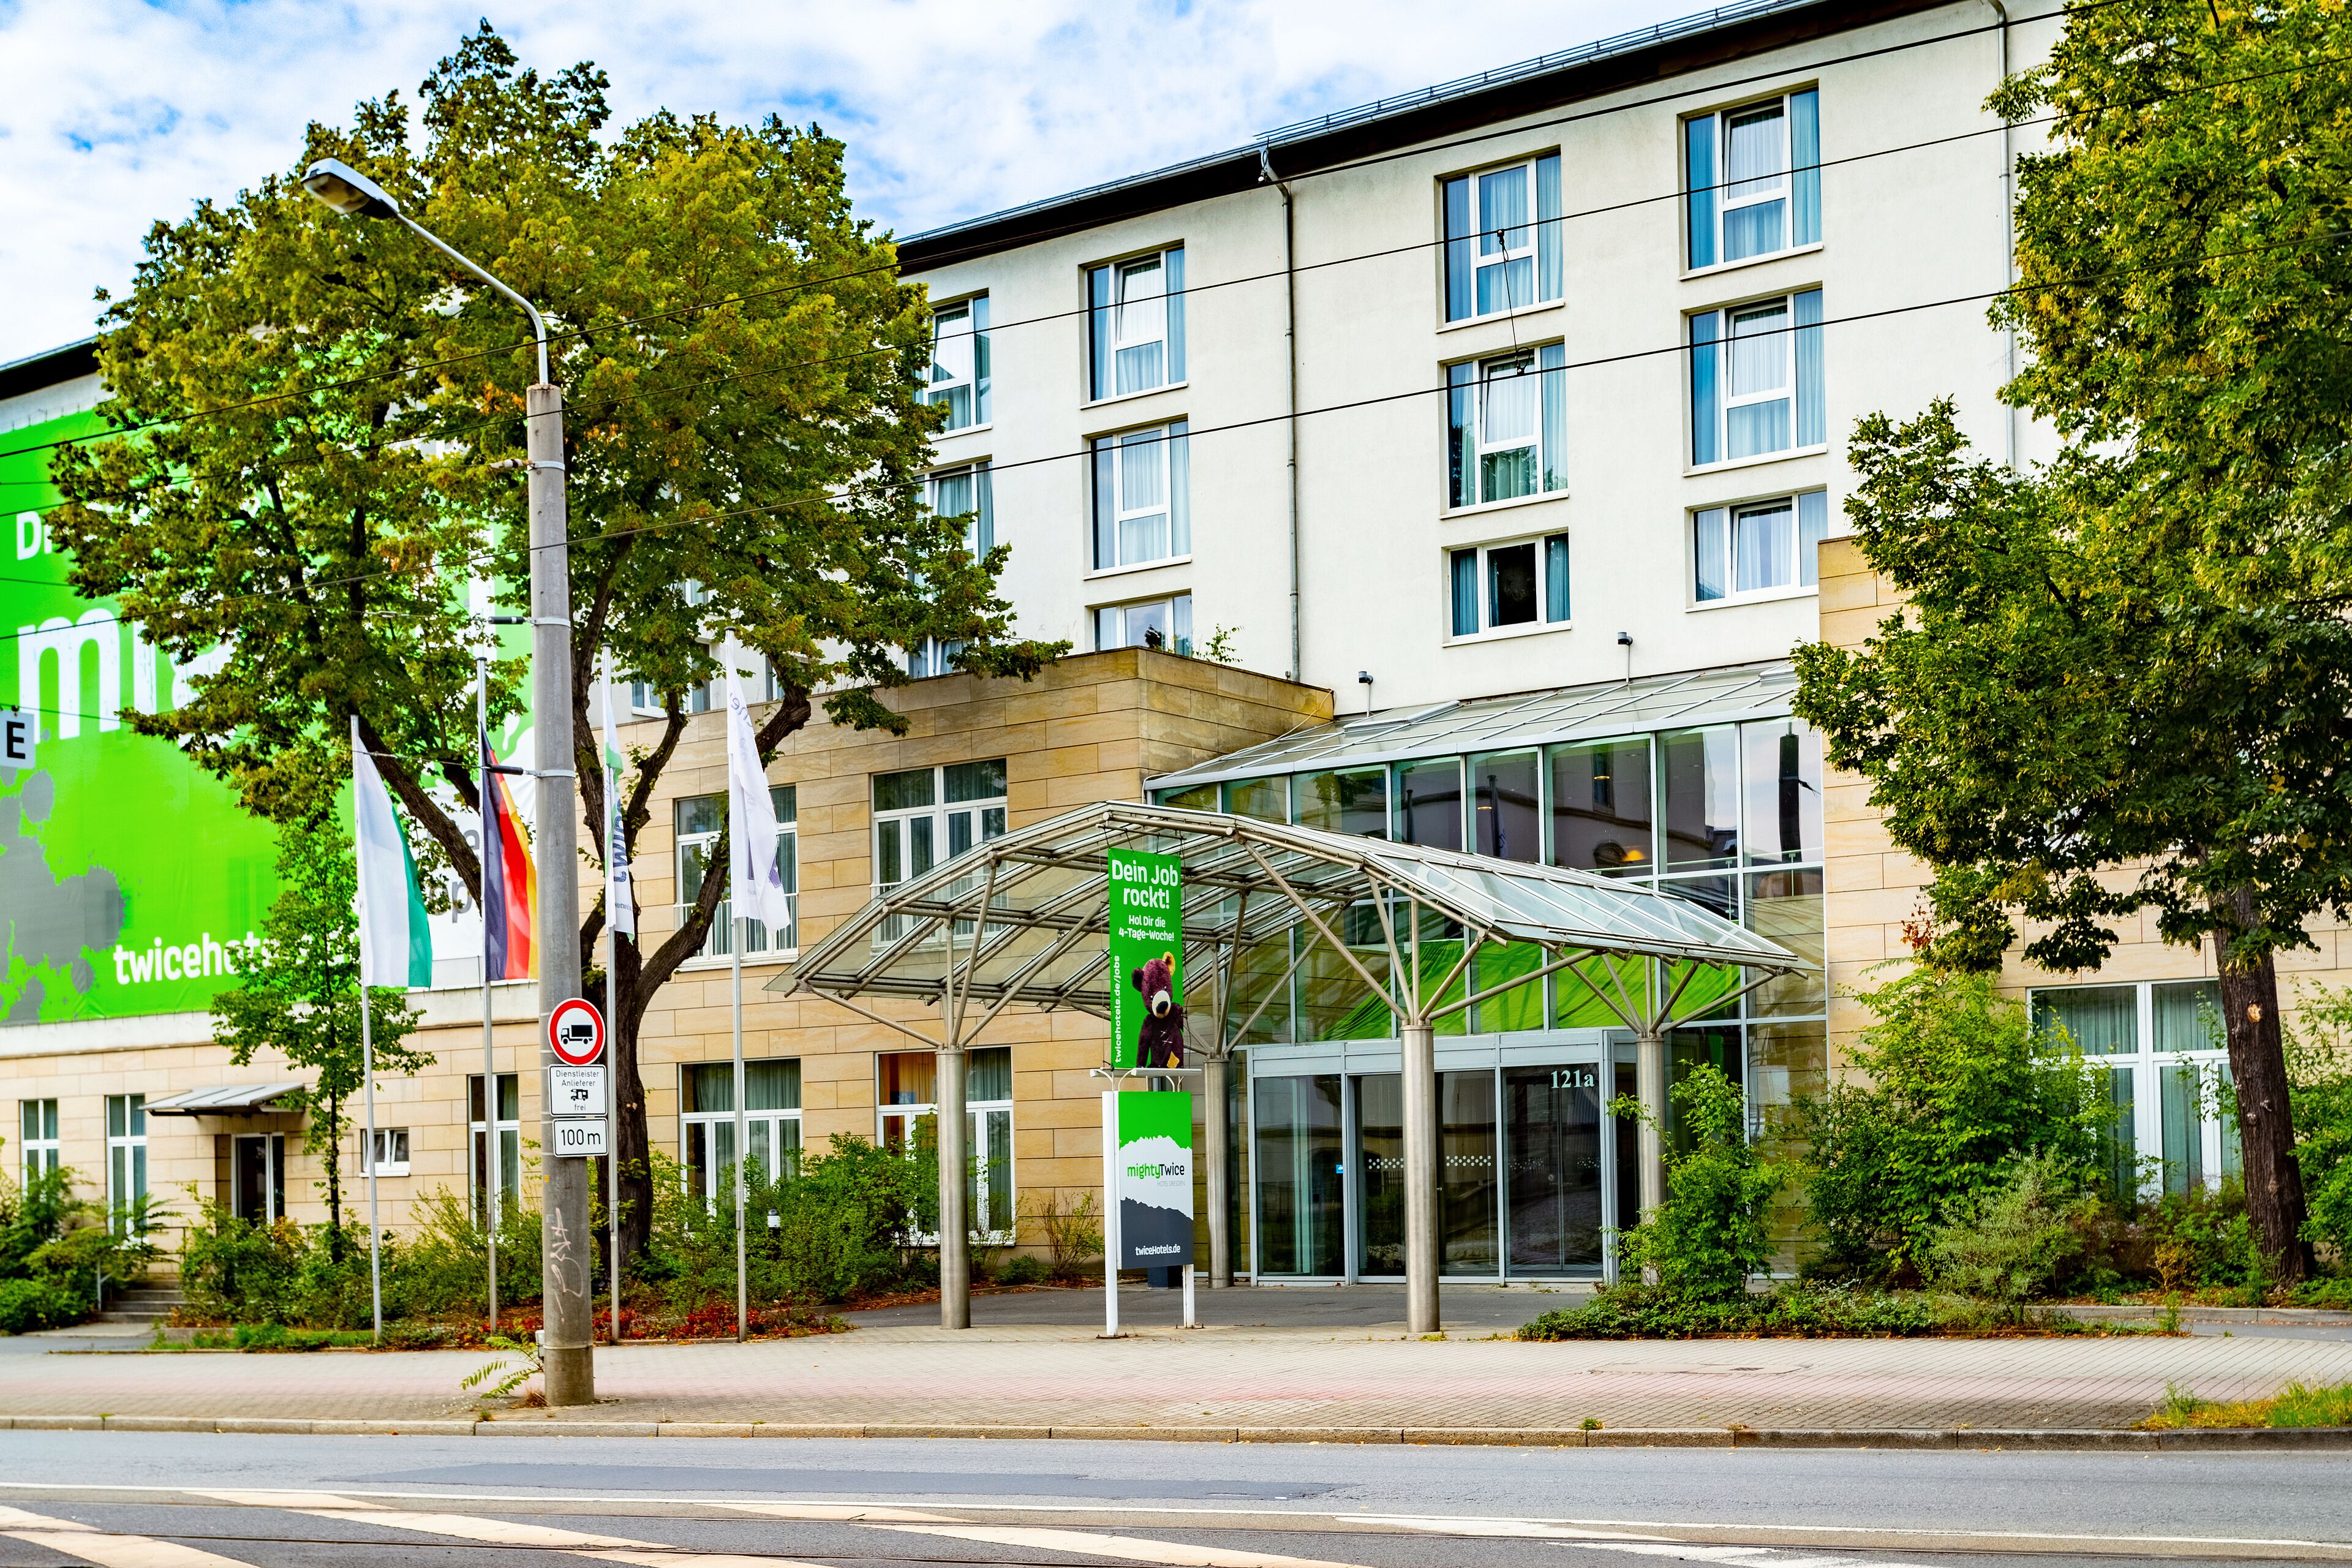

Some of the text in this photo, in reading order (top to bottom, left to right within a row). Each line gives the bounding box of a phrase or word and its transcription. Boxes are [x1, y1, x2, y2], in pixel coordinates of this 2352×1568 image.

[7, 721, 26, 760] E
[1112, 859, 1178, 887] Dein Job
[1123, 886, 1170, 909] rockt!
[1128, 914, 1166, 928] Hol Dir die
[1118, 927, 1175, 941] 4-Tage-Woche!
[1550, 1069, 1595, 1088] 121a
[561, 1129, 601, 1145] 100 m
[1127, 1162, 1185, 1179] mightyTwice
[1135, 1243, 1181, 1256] twiceHotels.de
